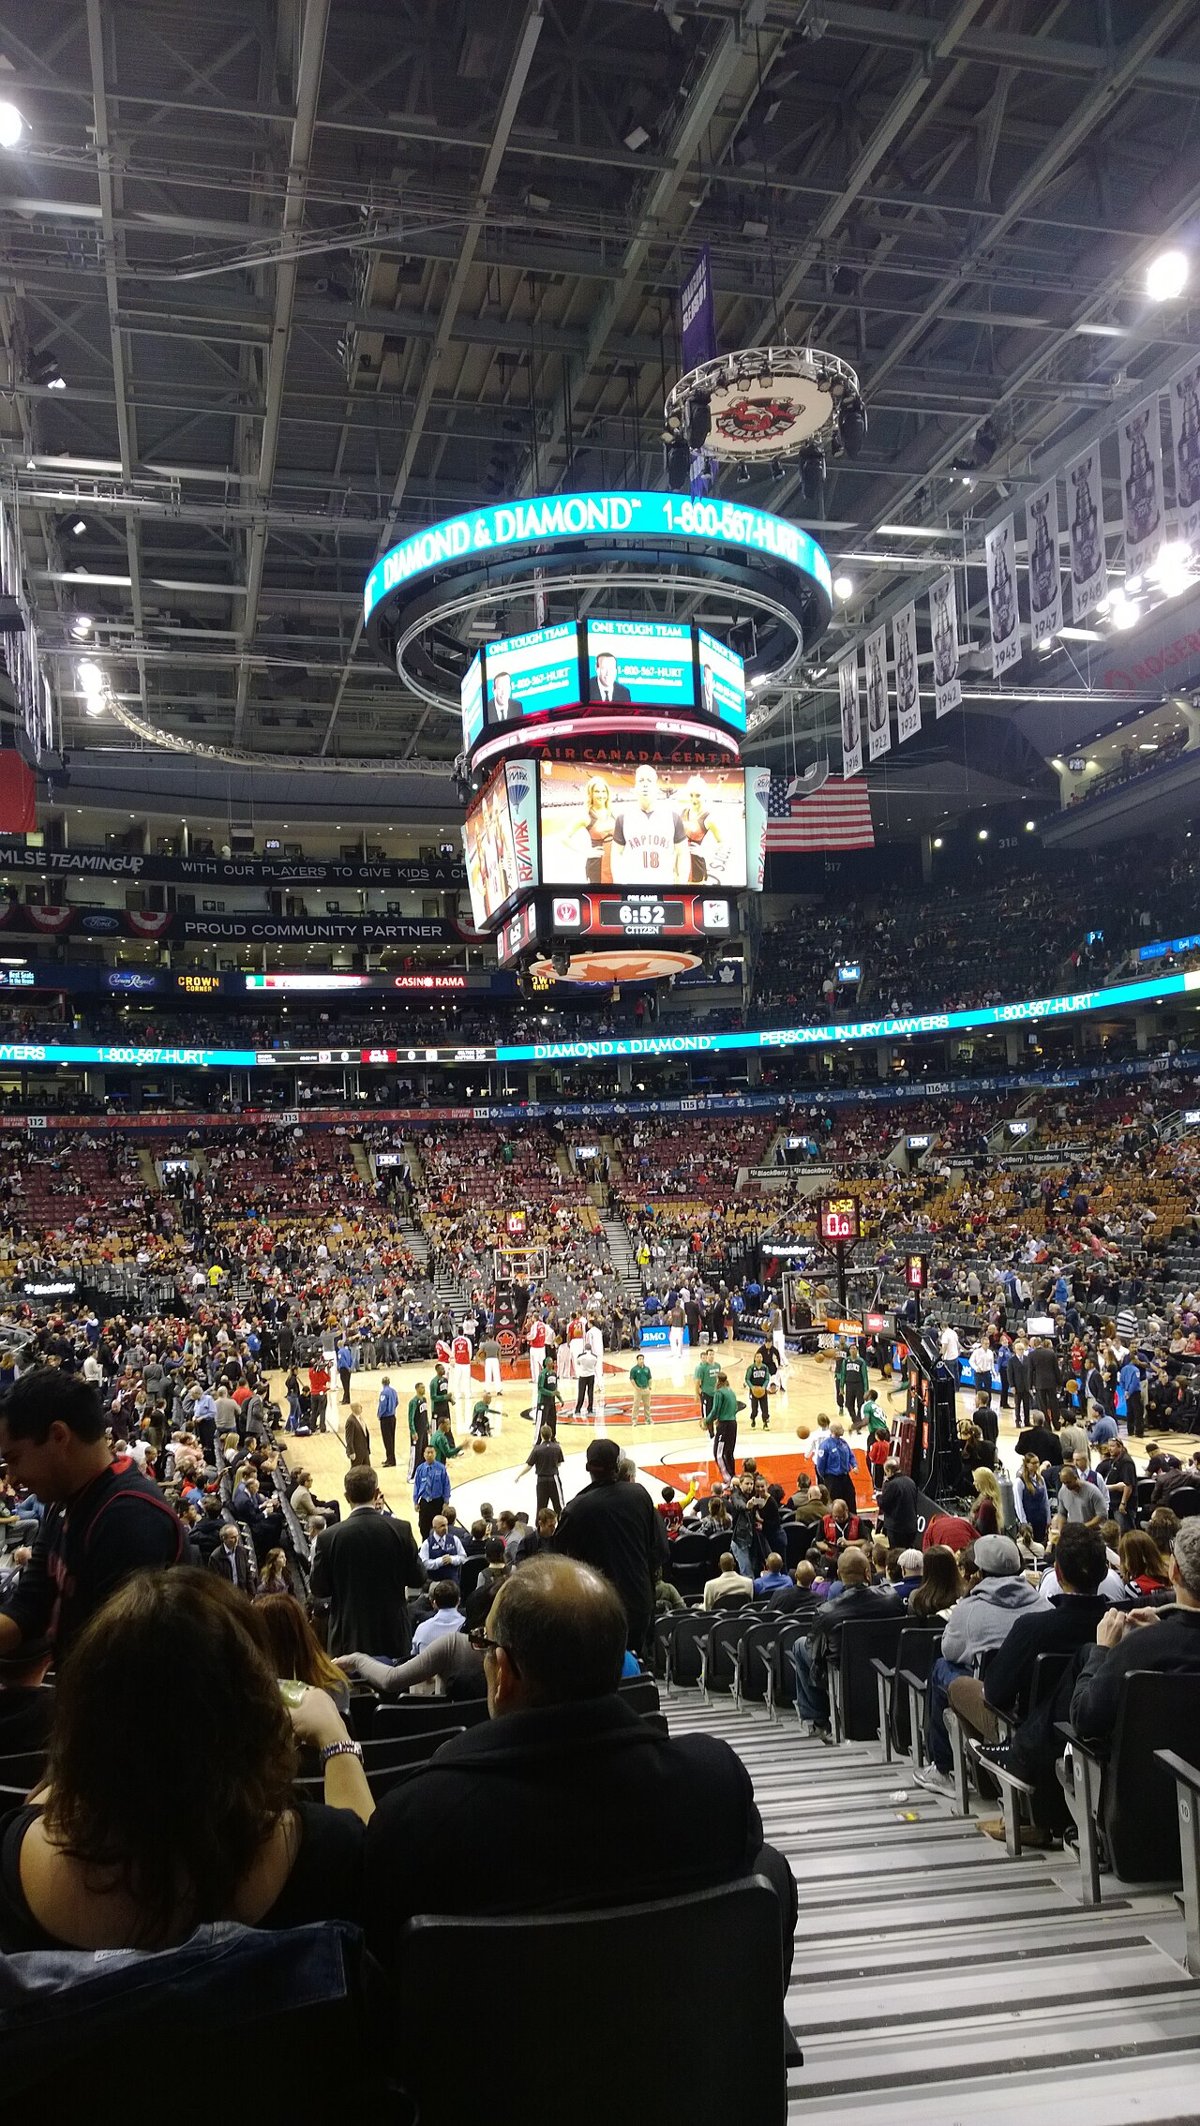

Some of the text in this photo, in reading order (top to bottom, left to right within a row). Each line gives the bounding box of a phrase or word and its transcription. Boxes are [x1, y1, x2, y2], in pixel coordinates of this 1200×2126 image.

[717, 419, 795, 440] RAPTORS
[383, 521, 470, 590] DIAMOND
[474, 518, 492, 549] &
[591, 622, 682, 637] ONE TOUGH TEAM
[1035, 611, 1057, 639] 1947
[489, 626, 569, 655] ONE TOUGH TEAM
[995, 642, 1017, 668] 1945
[939, 686, 957, 711] 1942
[901, 713, 917, 736] 1932
[872, 734, 888, 756] 1922
[541, 747, 742, 764] AIR CANADA CENTRE
[998, 837, 1018, 848] 318
[513, 819, 533, 882] RE/MAX
[0, 851, 46, 866] MLSE
[643, 851, 660, 869] 18
[181, 861, 217, 874] WITH
[223, 865, 255, 876] OUR
[262, 866, 326, 877] PLAYERS
[333, 866, 353, 877] TO
[359, 867, 391, 878] GIVE
[397, 867, 430, 878] KIDS
[435, 868, 445, 878] A
[619, 905, 665, 924] 6:52
[185, 922, 443, 937] PROUD COMMUNITY PARTNER
[624, 926, 660, 935] CITIZEN
[178, 976, 220, 987] CROWN
[185, 985, 213, 993] CORNER
[395, 977, 464, 987] CASINO RAMA
[993, 994, 1092, 1021] 1-800-567-HURT
[759, 1014, 949, 1046] PERSONAL INJURY LAWYERS
[534, 1037, 712, 1059] DIAMOND & DIAMOND
[97, 1048, 205, 1064] 1-800-567-HURT
[927, 1084, 940, 1093] 116
[682, 1101, 695, 1109] 115
[29, 1118, 44, 1126] 112
[909, 1137, 928, 1147] IBM
[378, 1155, 398, 1164] IBM
[1034, 1154, 1059, 1162] BlackBerry
[801, 1167, 833, 1175] BlackBerry
[829, 1199, 853, 1212] 6:52
[827, 1213, 849, 1236] 0.0
[642, 1332, 666, 1341] BMO
[1181, 1804, 1189, 1818] 10
